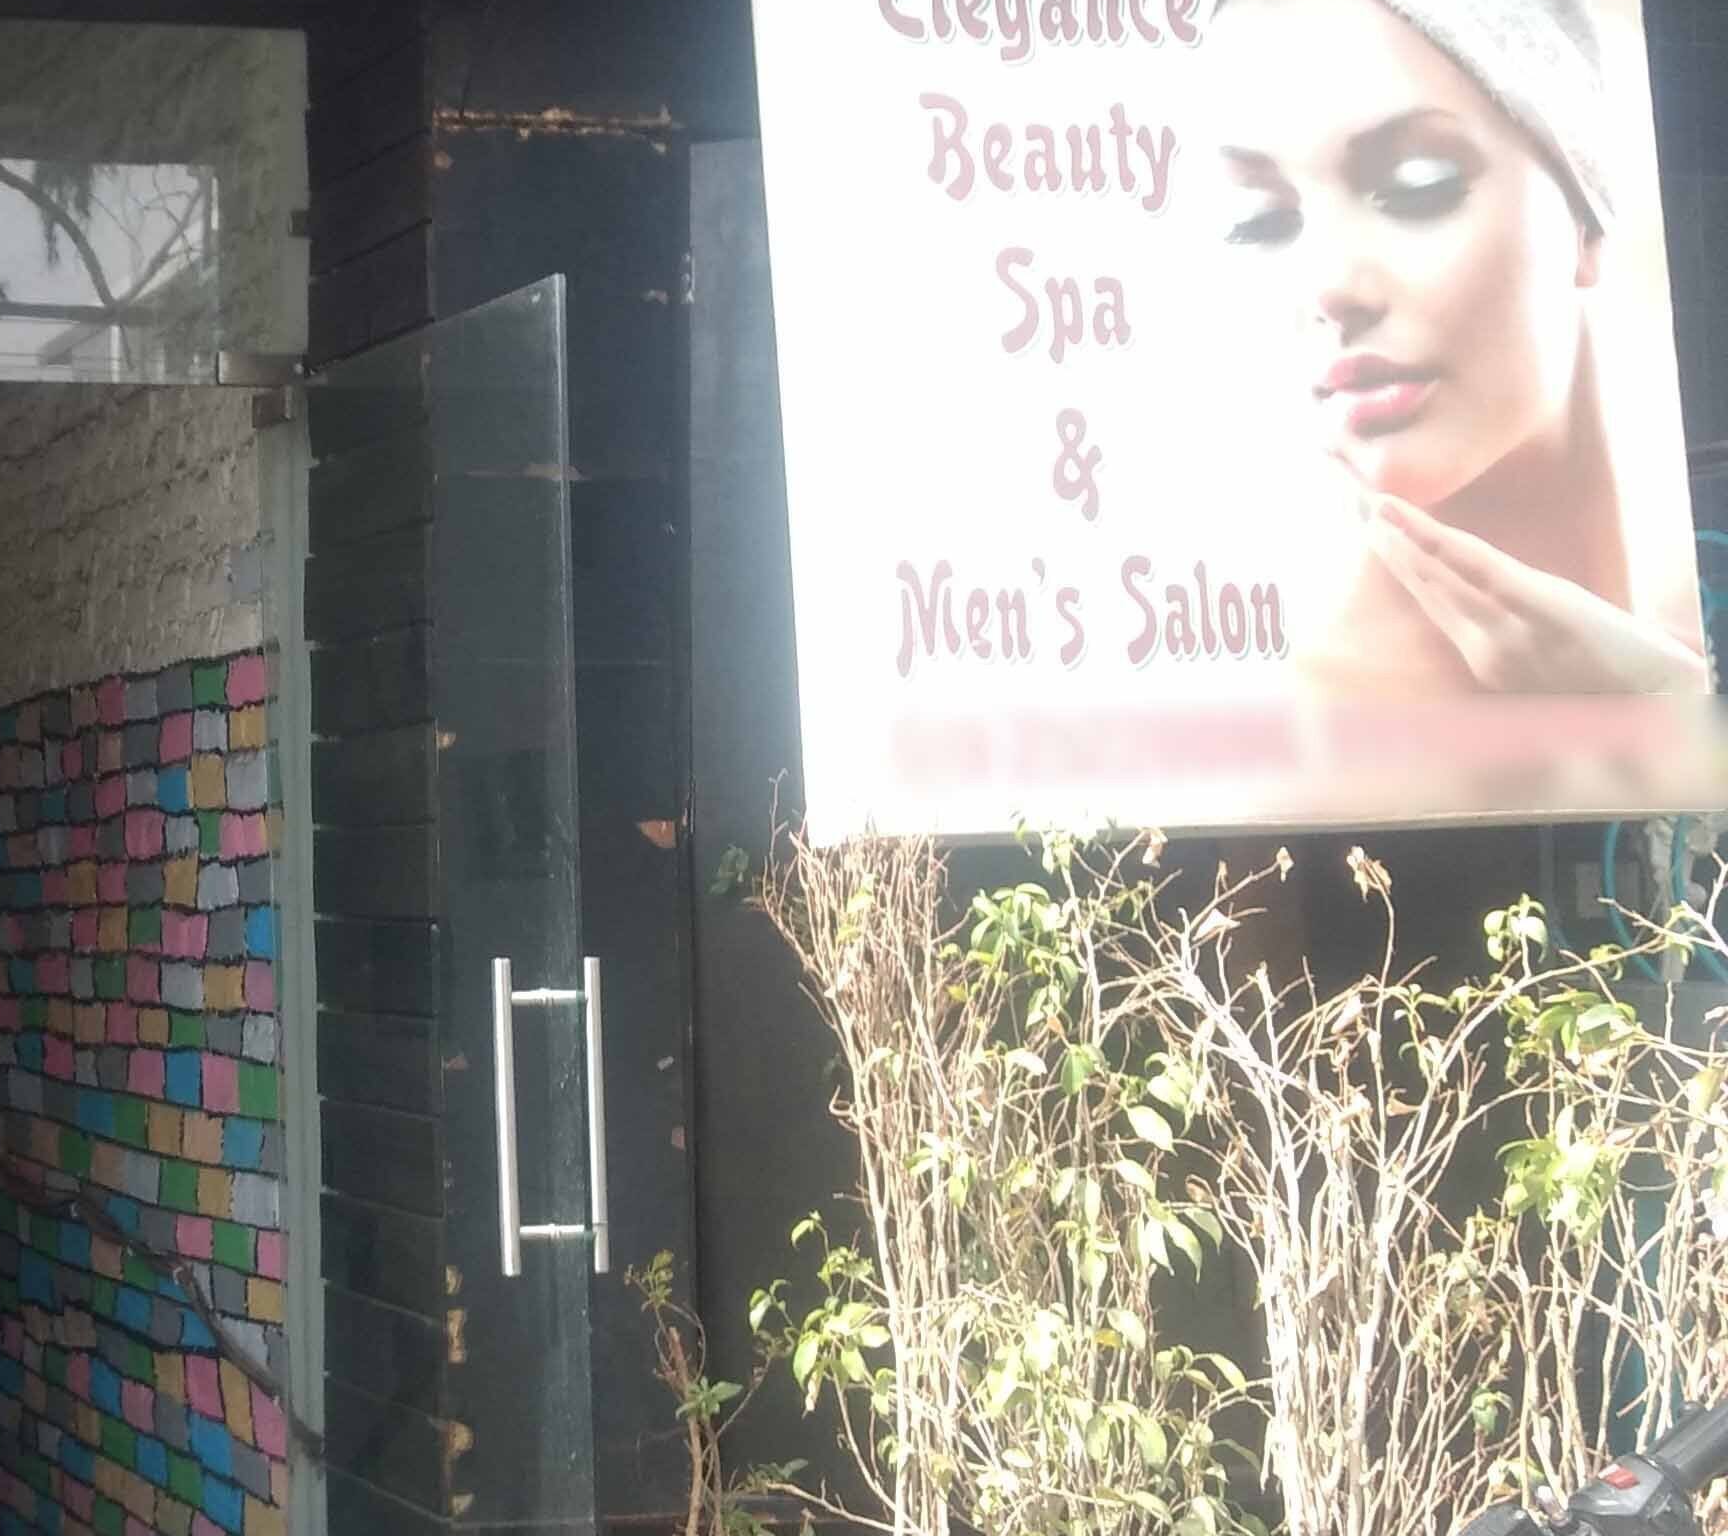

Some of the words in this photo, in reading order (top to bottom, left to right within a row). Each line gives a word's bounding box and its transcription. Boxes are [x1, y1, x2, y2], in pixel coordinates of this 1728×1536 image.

[918, 92, 1178, 210] Beauty
[994, 247, 1132, 364] Spa
[1050, 407, 1104, 522] &
[895, 558, 1086, 677] Men's
[1123, 554, 1289, 667] Salon
